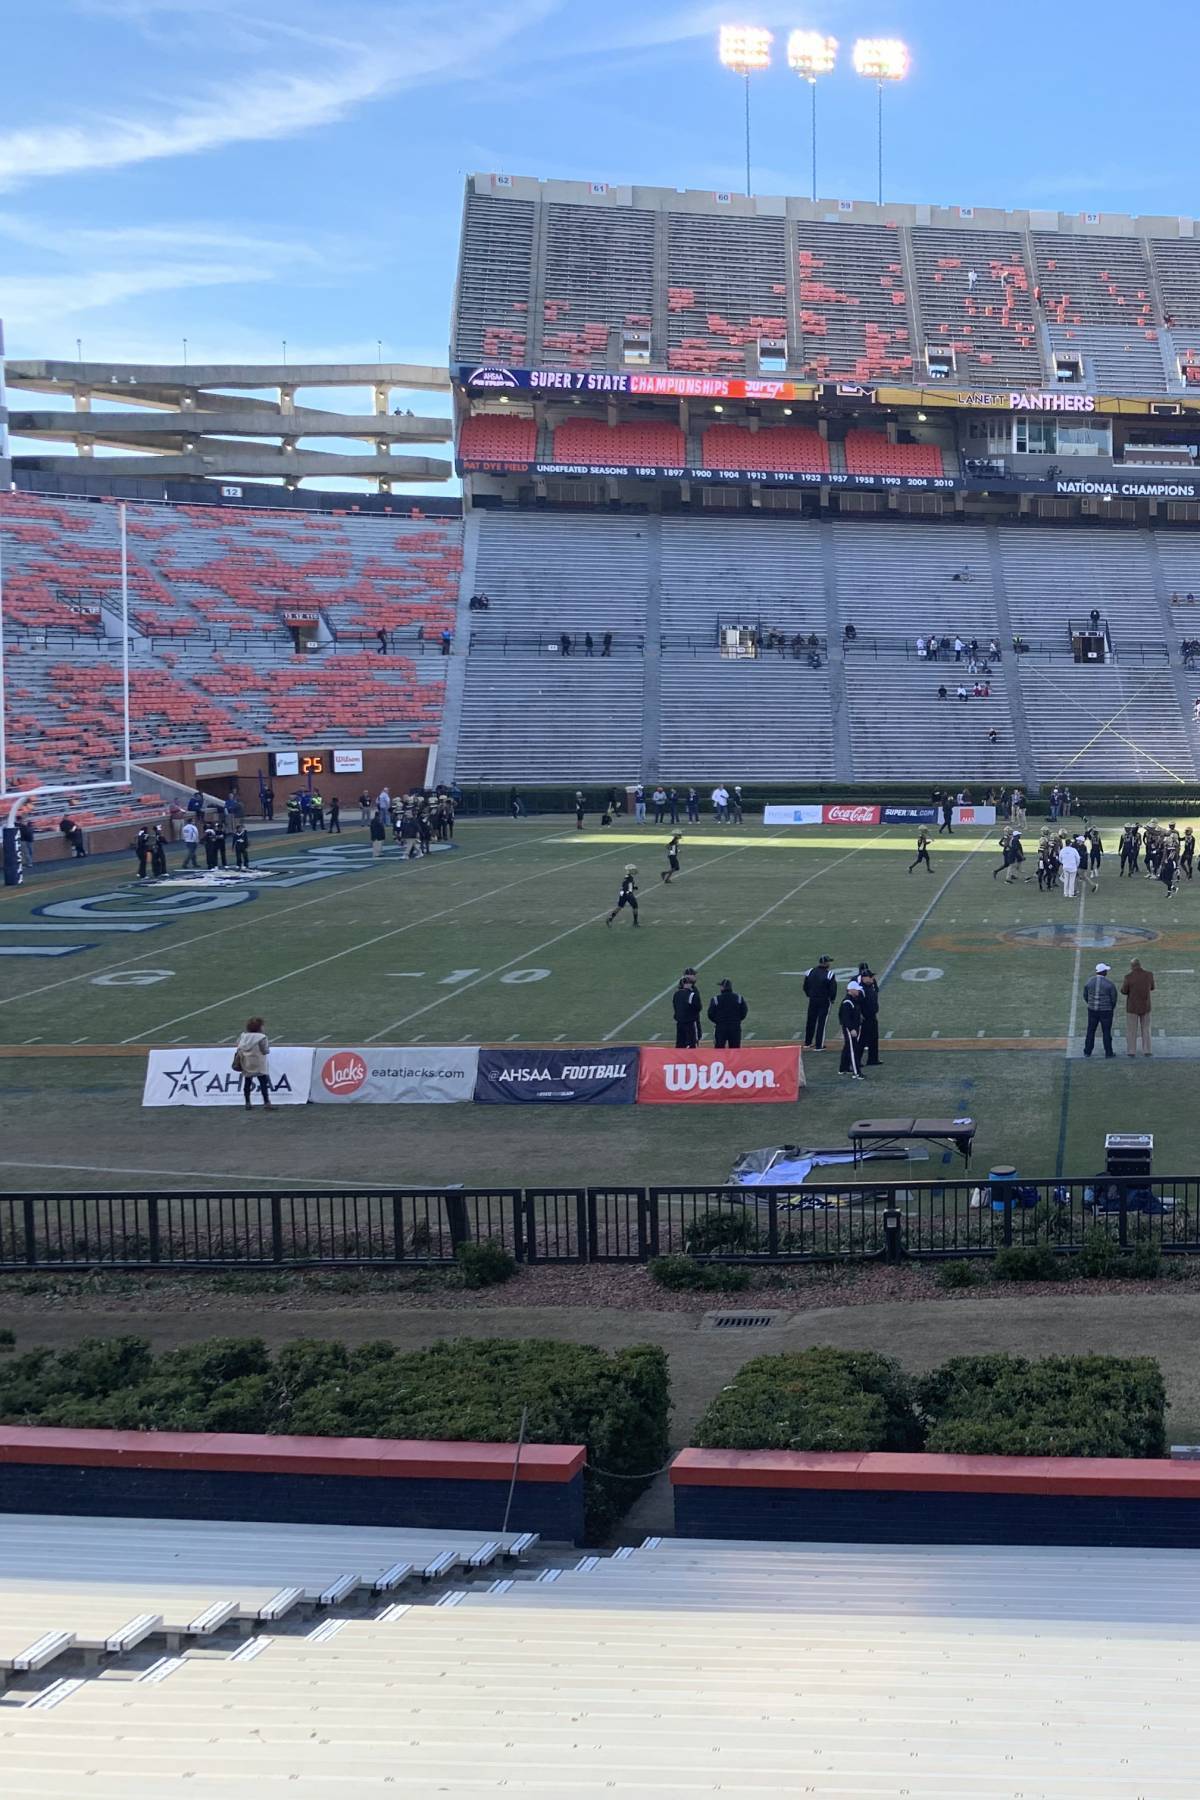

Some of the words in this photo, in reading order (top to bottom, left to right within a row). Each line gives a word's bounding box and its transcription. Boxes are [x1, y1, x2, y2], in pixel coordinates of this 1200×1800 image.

[530, 371, 571, 388] SUPER
[576, 374, 586, 389] 7
[588, 375, 626, 390] STATE
[630, 376, 728, 394] CHAMPIONSHIPS
[958, 393, 1005, 405] LANETT
[1010, 393, 1095, 412] PANTHERS
[464, 462, 480, 470] PAT
[504, 463, 528, 472] FIELD
[536, 464, 588, 474] UNDEFEATED
[590, 466, 628, 475] SEASONS
[636, 468, 656, 476] 1893
[664, 468, 684, 477] 1897
[692, 470, 712, 478] 1900
[1057, 482, 1118, 494] NATIONAL
[1122, 484, 1195, 496] CHAMPIONS
[303, 758, 322, 773] 25
[324, 1060, 364, 1087] Jack's
[372, 1066, 465, 1079] eatatjacks.com
